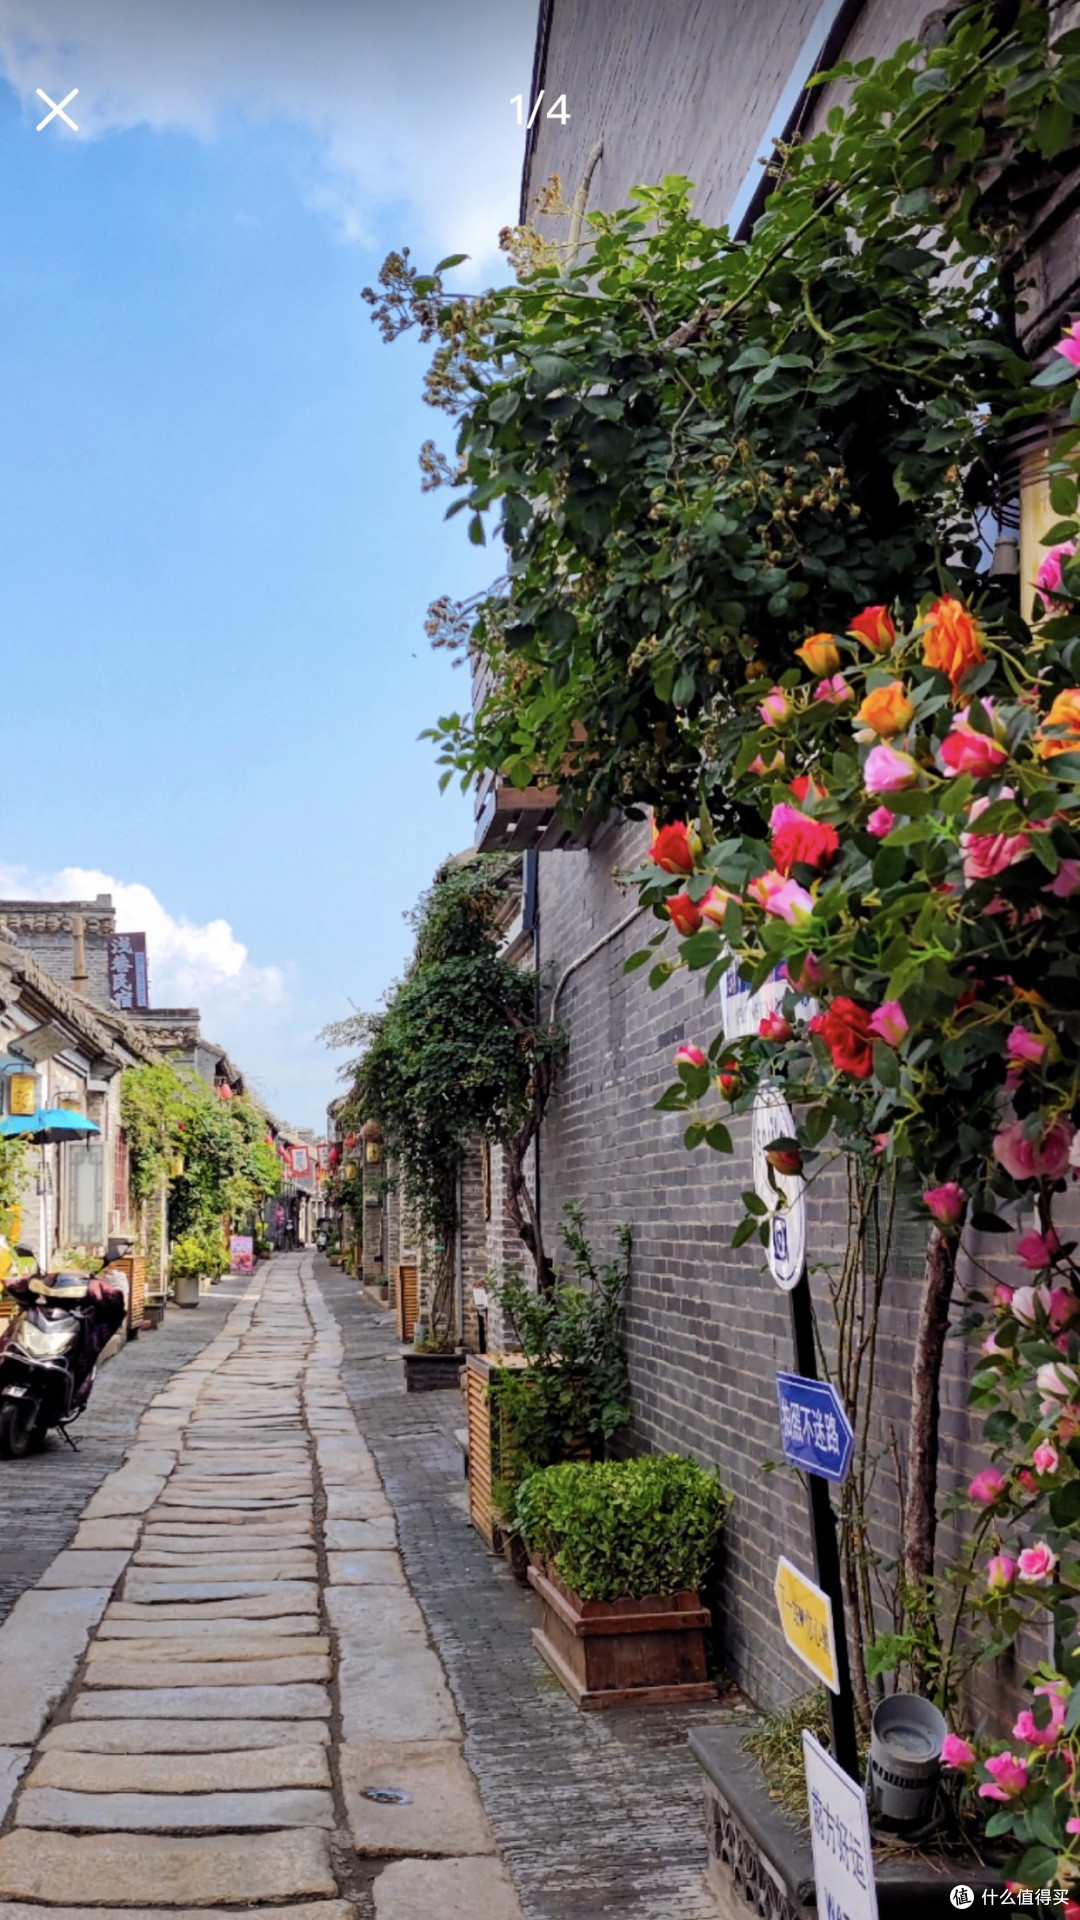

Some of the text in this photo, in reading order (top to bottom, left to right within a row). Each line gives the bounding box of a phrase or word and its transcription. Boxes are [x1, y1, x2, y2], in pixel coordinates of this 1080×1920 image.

[781, 1397, 840, 1456] 拍照不迷路
[811, 1787, 866, 1890] 前方好运
